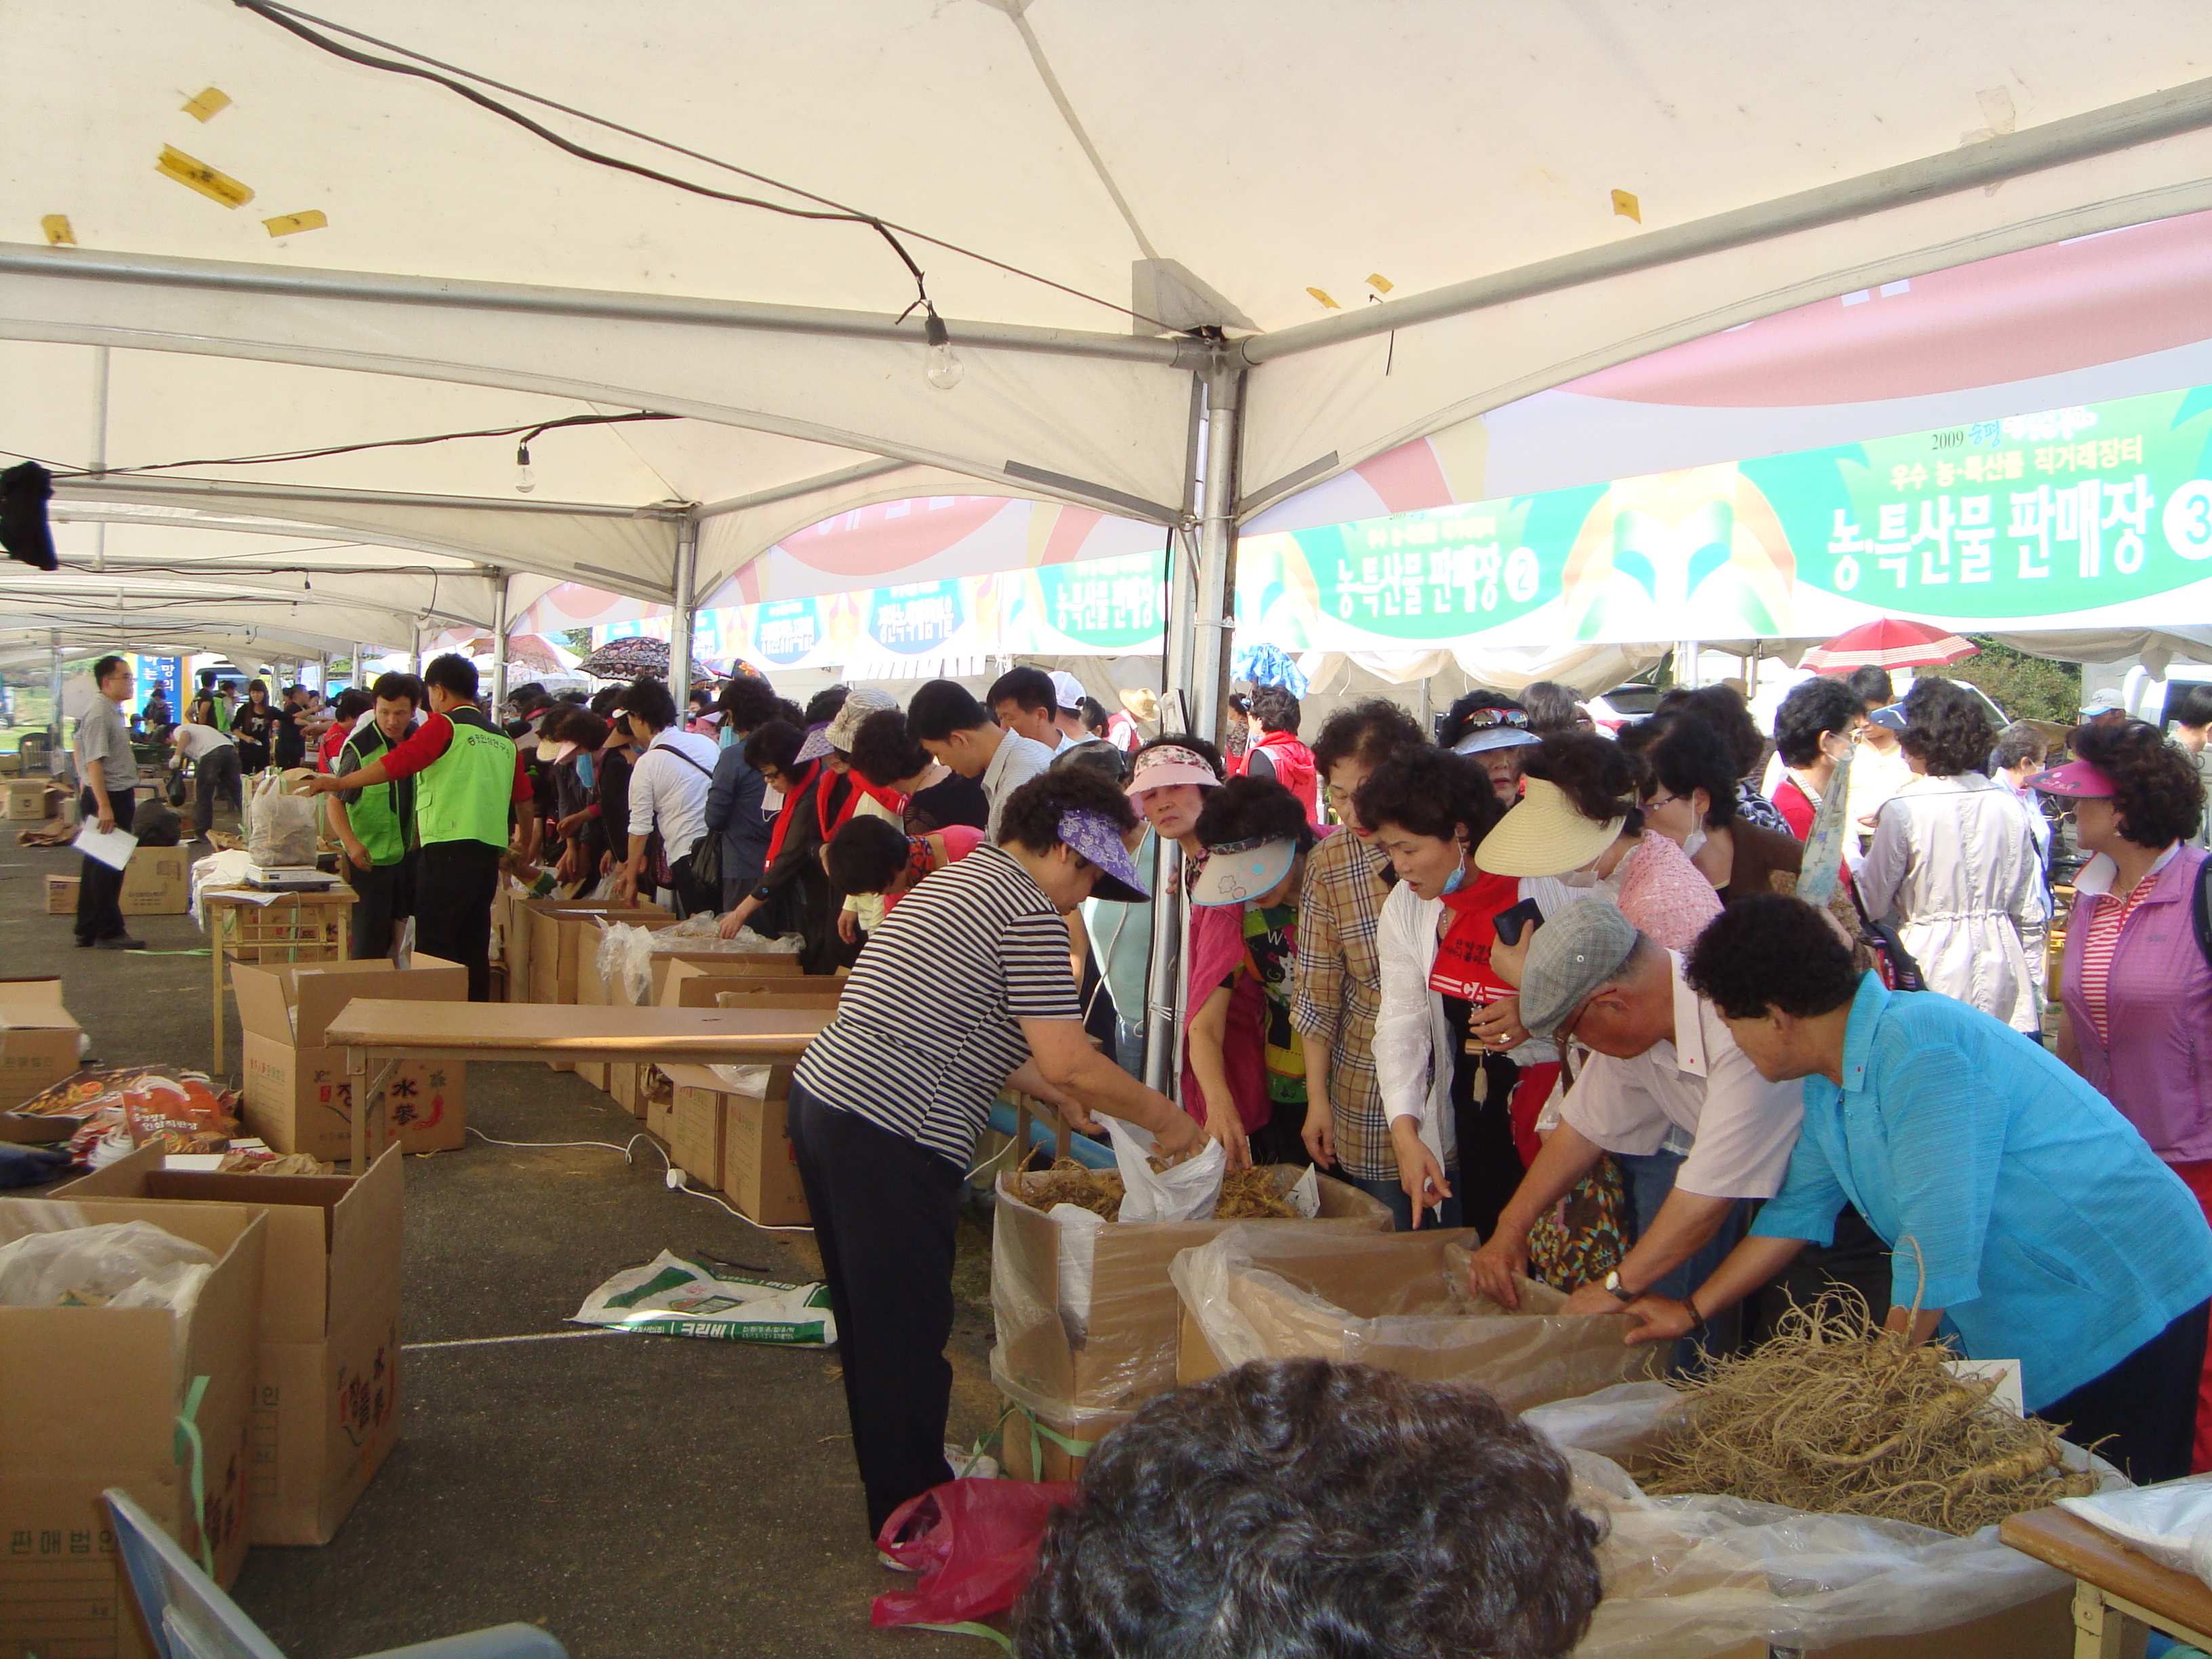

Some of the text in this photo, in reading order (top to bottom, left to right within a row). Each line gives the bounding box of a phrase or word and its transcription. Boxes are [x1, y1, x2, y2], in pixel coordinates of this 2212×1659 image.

[1890, 463, 1929, 491] 우수
[2034, 434, 2143, 474] 직거래장터
[1931, 430, 1965, 451] 2009
[2007, 474, 2154, 579] 판매장
[1428, 541, 1502, 613] 판매장
